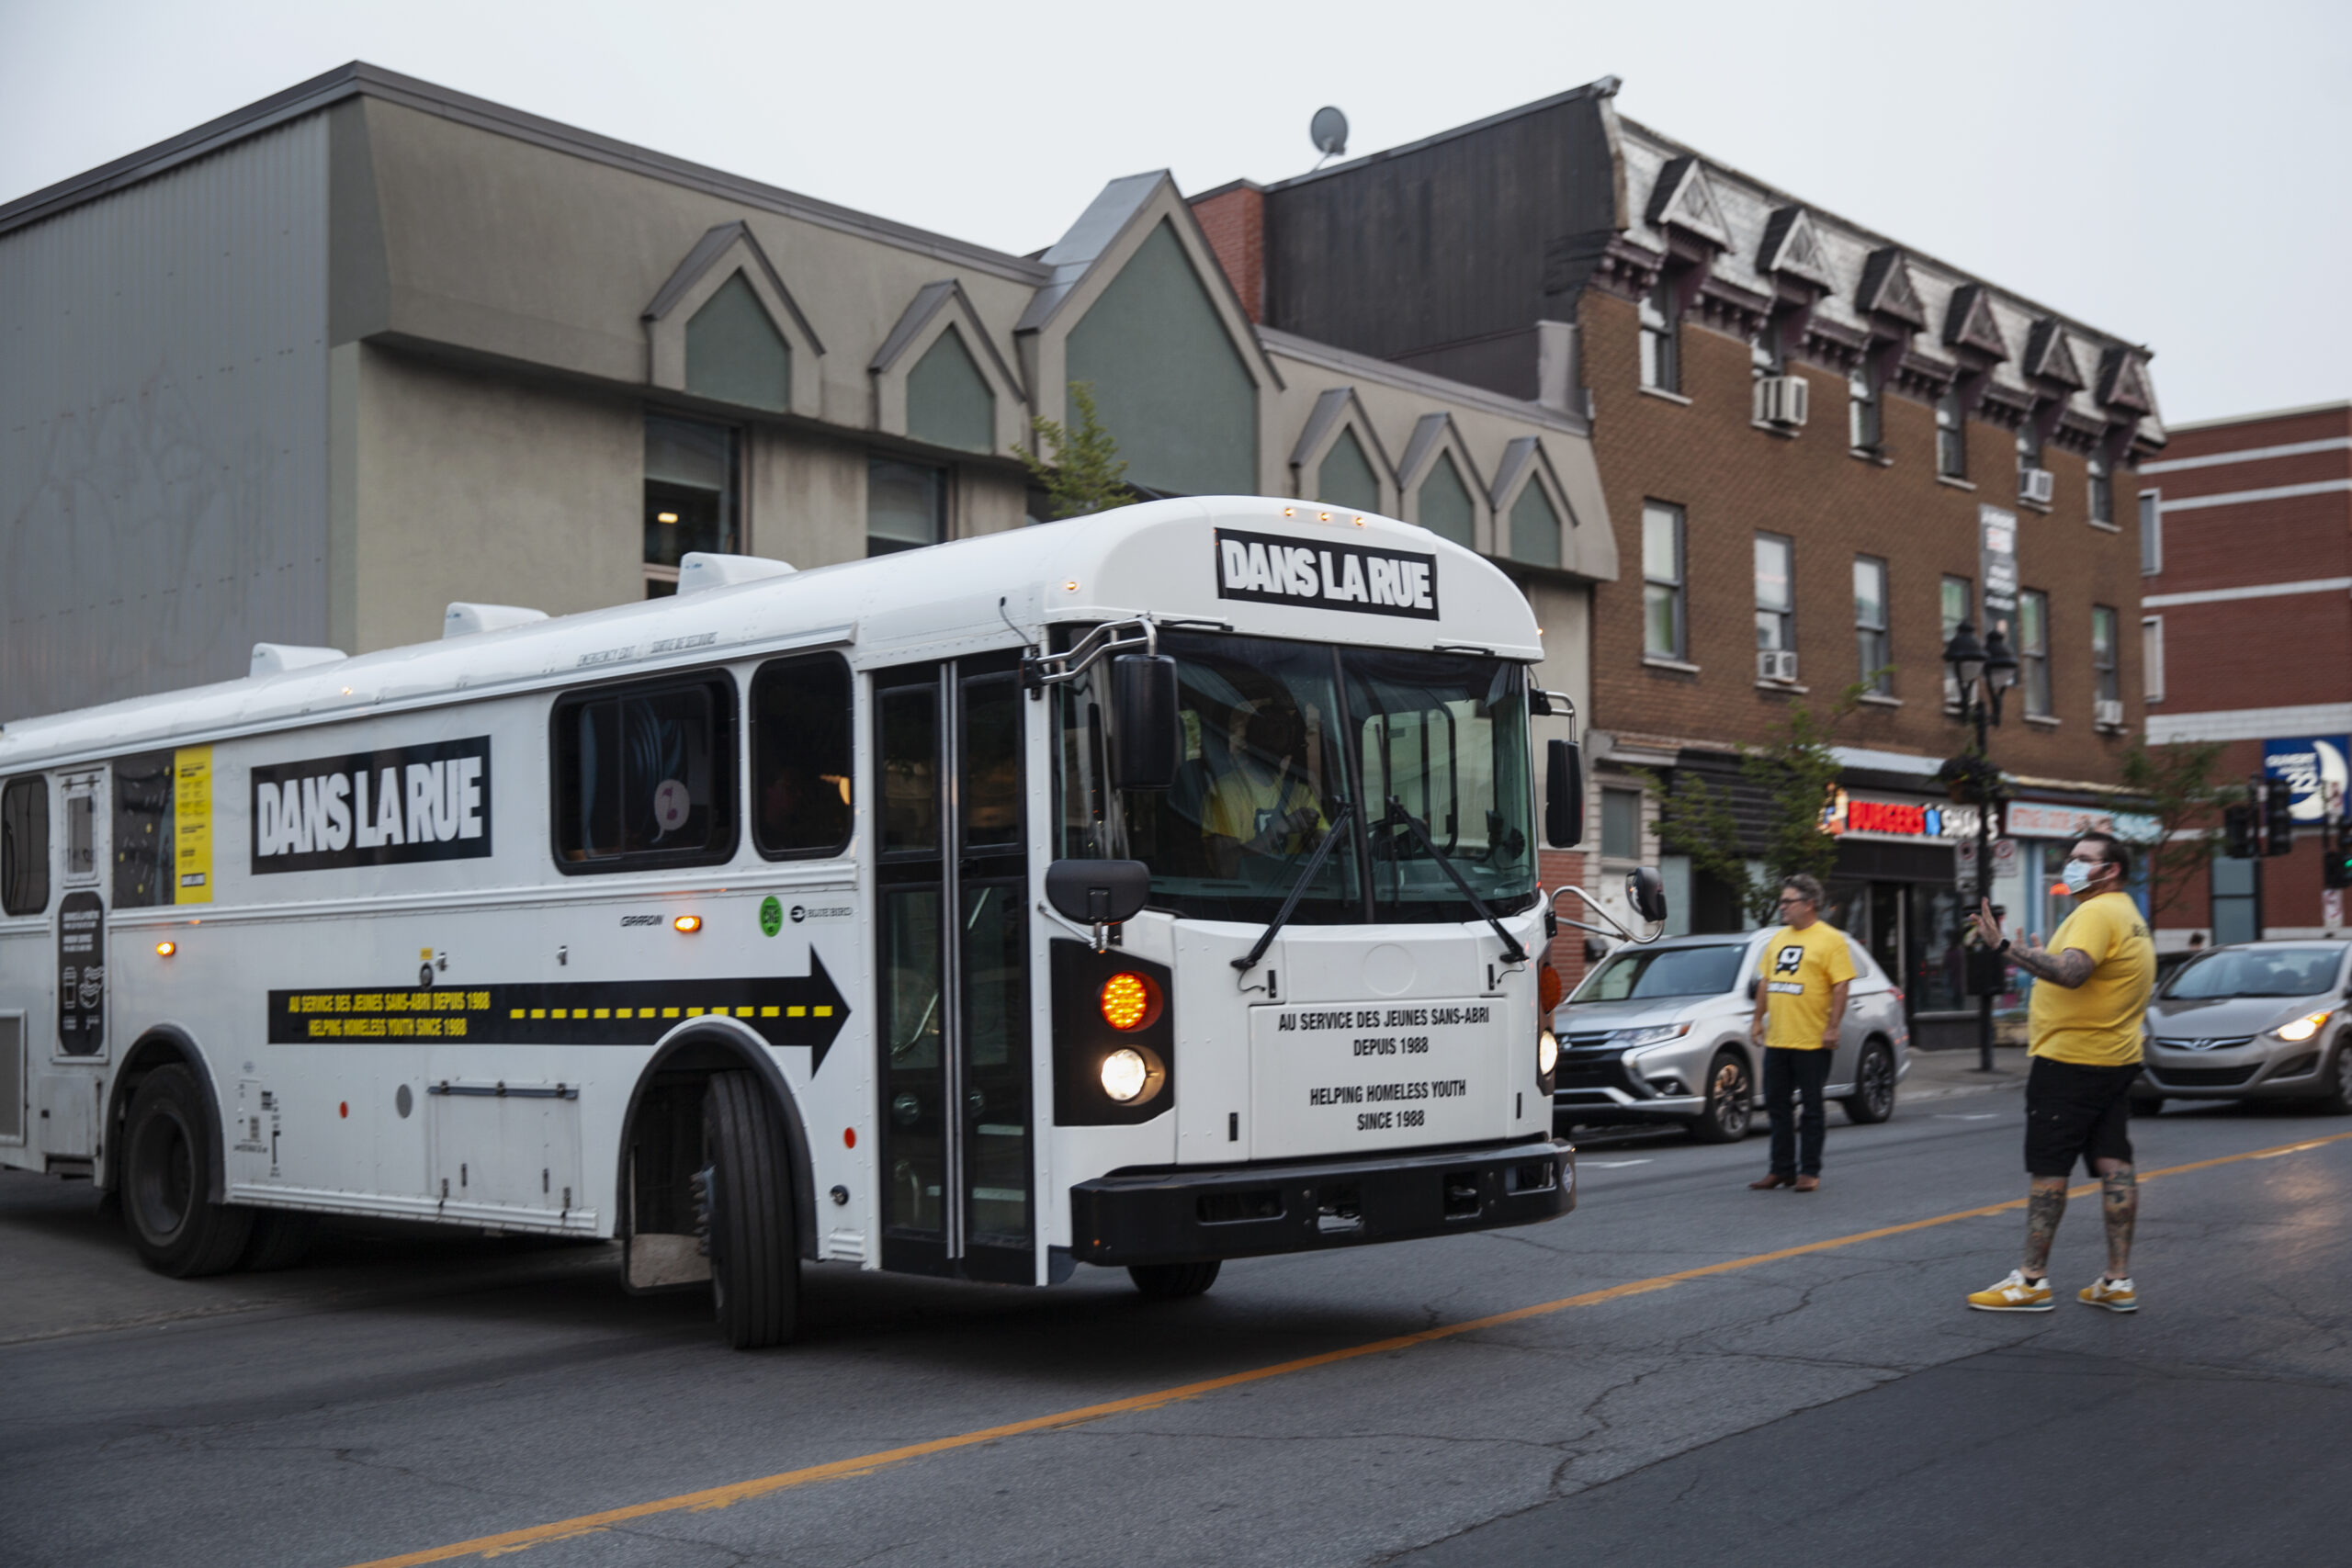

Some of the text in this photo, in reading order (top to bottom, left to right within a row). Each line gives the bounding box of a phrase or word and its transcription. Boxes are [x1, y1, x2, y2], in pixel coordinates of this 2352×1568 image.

[1220, 539, 1433, 610] DANS LA RUE
[258, 773, 352, 857] DANS
[355, 766, 405, 848] LA
[406, 756, 482, 844] RUE
[1849, 800, 1925, 834] BURGERS
[288, 991, 491, 1012] AU SERVICE DES JEUNES SANS-ABRI DEPUIS 1988
[309, 1018, 467, 1036] HELPING HOMELESS YOUTH SINCE 1988
[1278, 1007, 1489, 1032] AU SERVICE DES JEUNES SANS-ABRI
[1353, 1036, 1429, 1056] DEPUIS 1988
[1310, 1079, 1466, 1106] HELPING HOMELESS YOUTH
[1357, 1110, 1425, 1131] SINCE 1988
